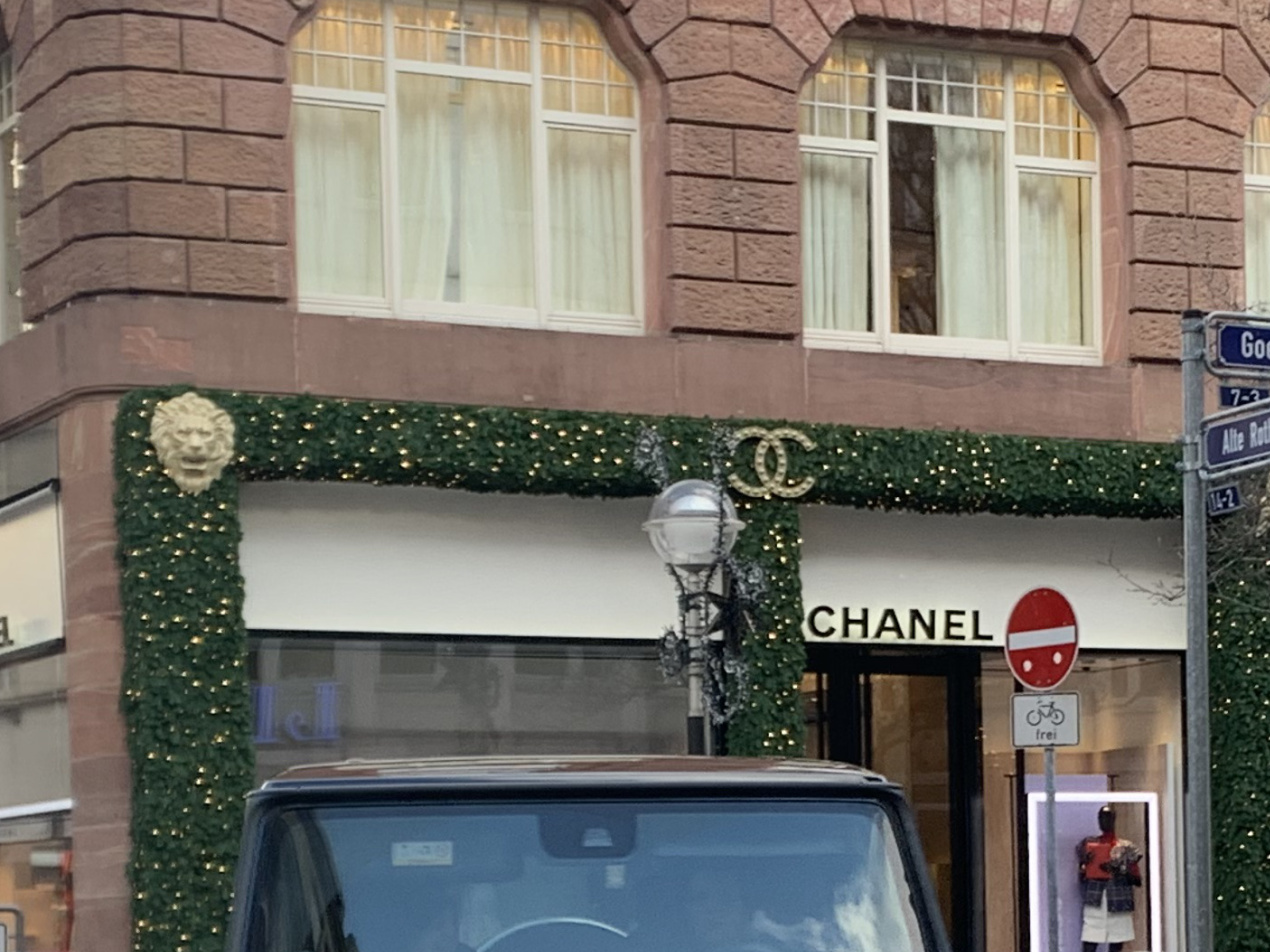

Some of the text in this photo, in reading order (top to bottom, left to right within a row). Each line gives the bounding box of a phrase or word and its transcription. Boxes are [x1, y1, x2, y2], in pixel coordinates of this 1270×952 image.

[1221, 428, 1245, 456] Alte
[1209, 488, 1235, 512] 14-2
[808, 605, 993, 641] CHANEL
[1035, 728, 1058, 741] frei
